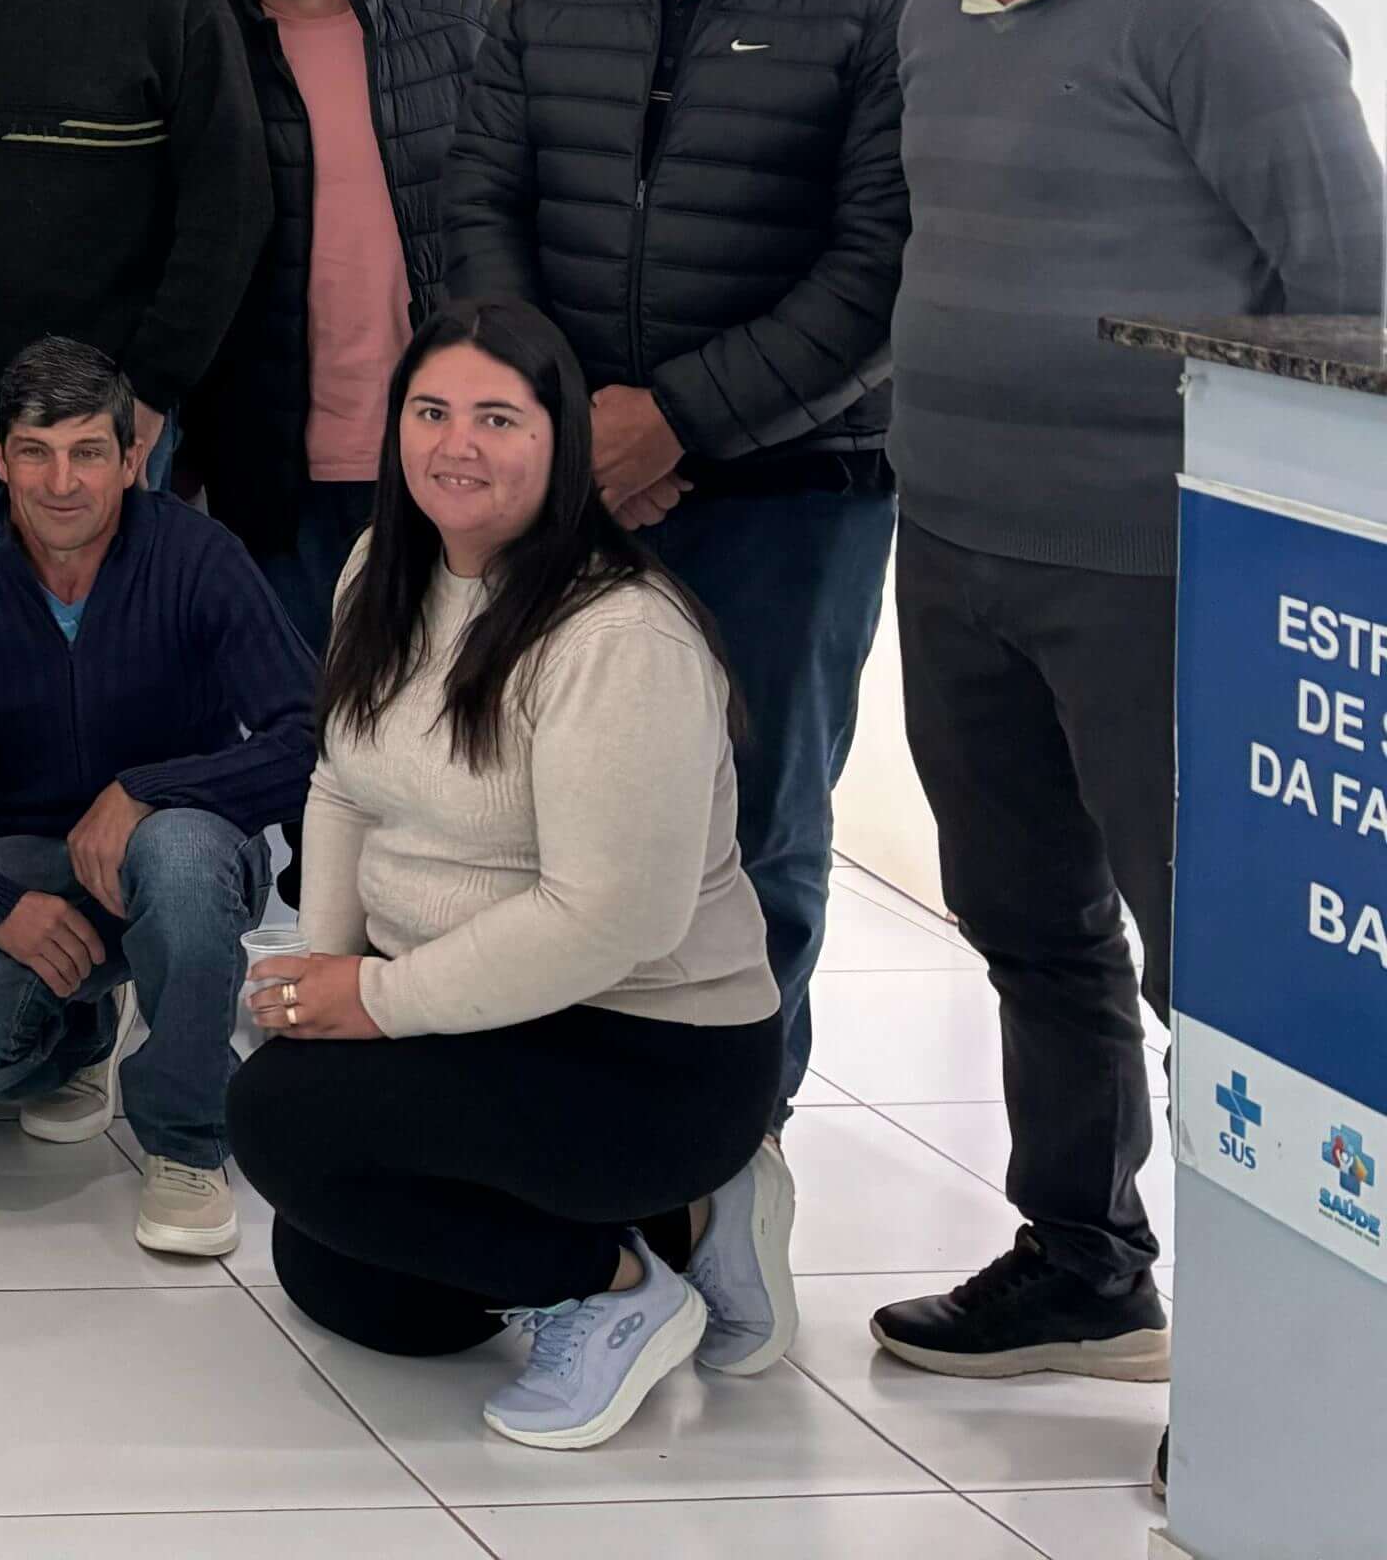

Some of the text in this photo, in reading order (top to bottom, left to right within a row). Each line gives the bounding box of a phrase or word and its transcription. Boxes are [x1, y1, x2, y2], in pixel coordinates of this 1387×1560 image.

[1297, 678, 1365, 752] DE
[1250, 741, 1387, 844] DA FA
[1309, 881, 1387, 970] BA
[1219, 1132, 1257, 1170] SUS
[1319, 1187, 1381, 1238] SAÚDE
